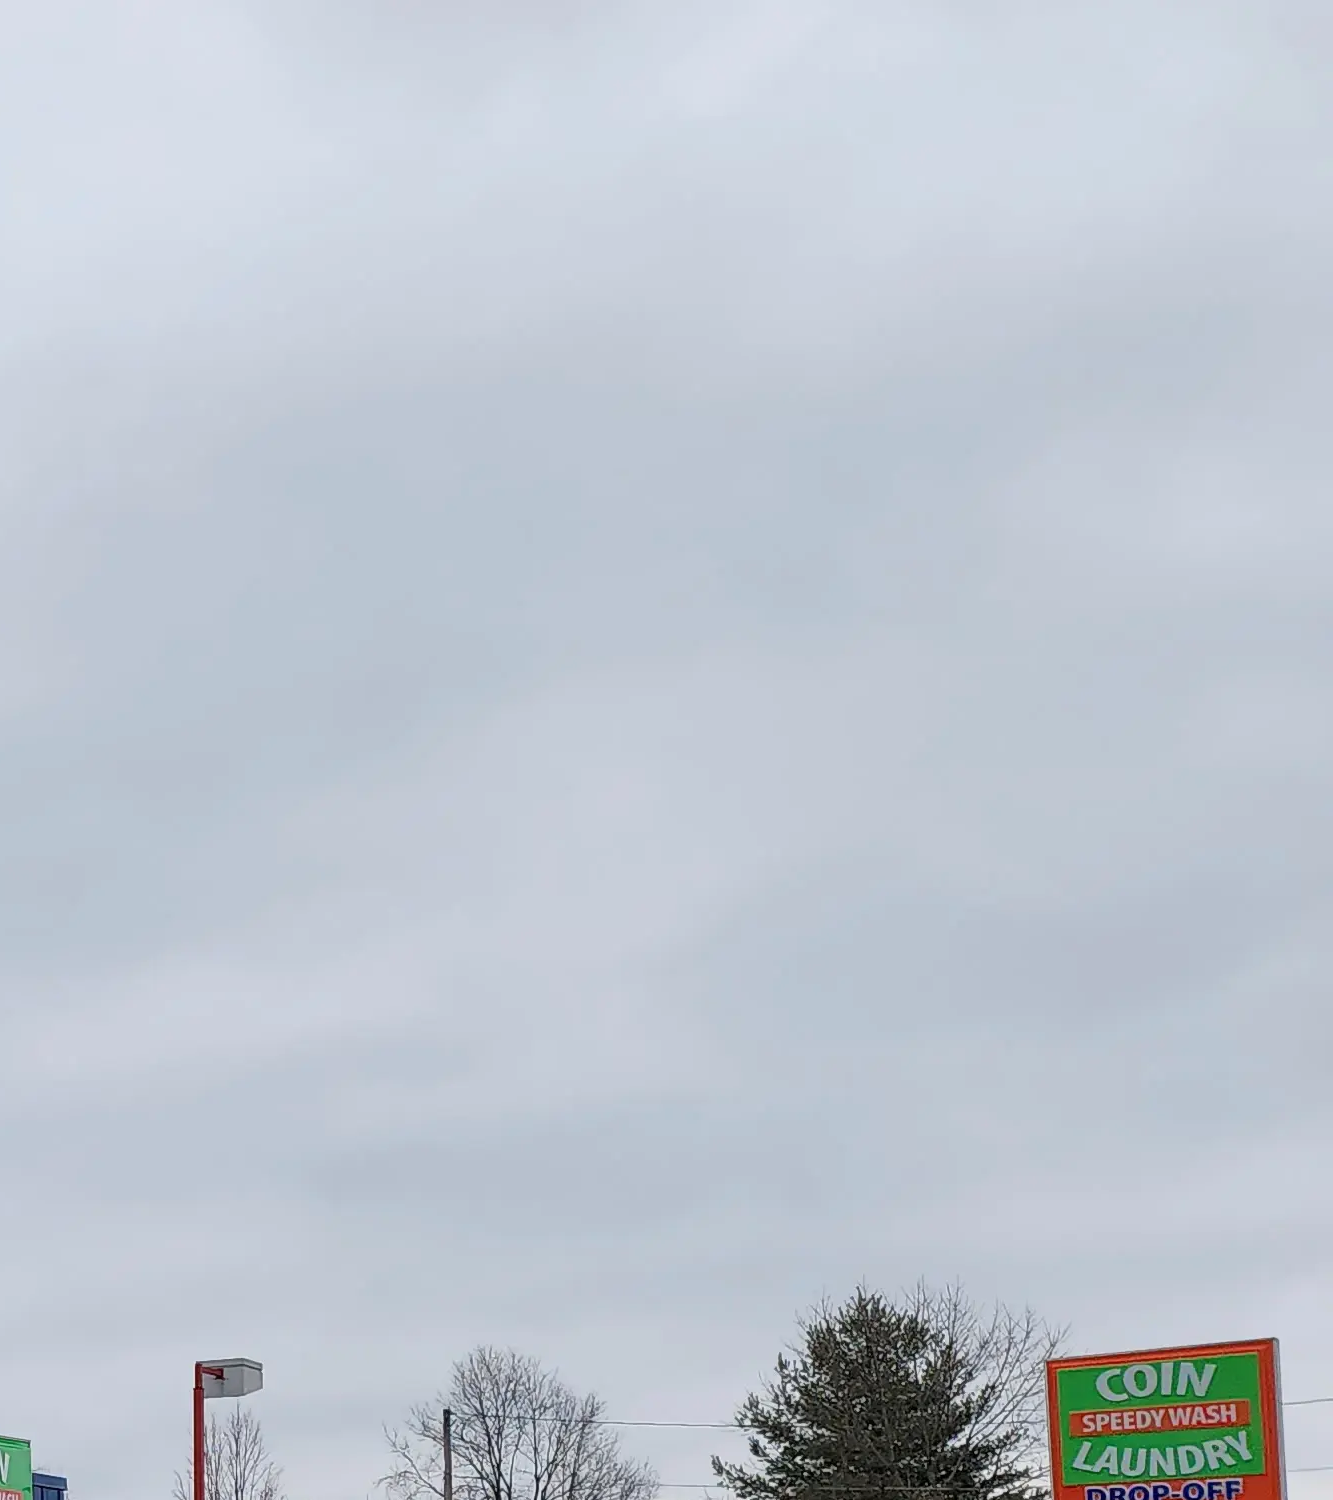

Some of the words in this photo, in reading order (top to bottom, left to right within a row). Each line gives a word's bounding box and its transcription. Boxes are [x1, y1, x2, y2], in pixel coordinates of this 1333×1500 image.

[1095, 1362, 1217, 1402] COIN
[1082, 1409, 1166, 1432] SPEEDY
[1167, 1403, 1237, 1427] WASH
[1072, 1430, 1253, 1477] LAUNDRY
